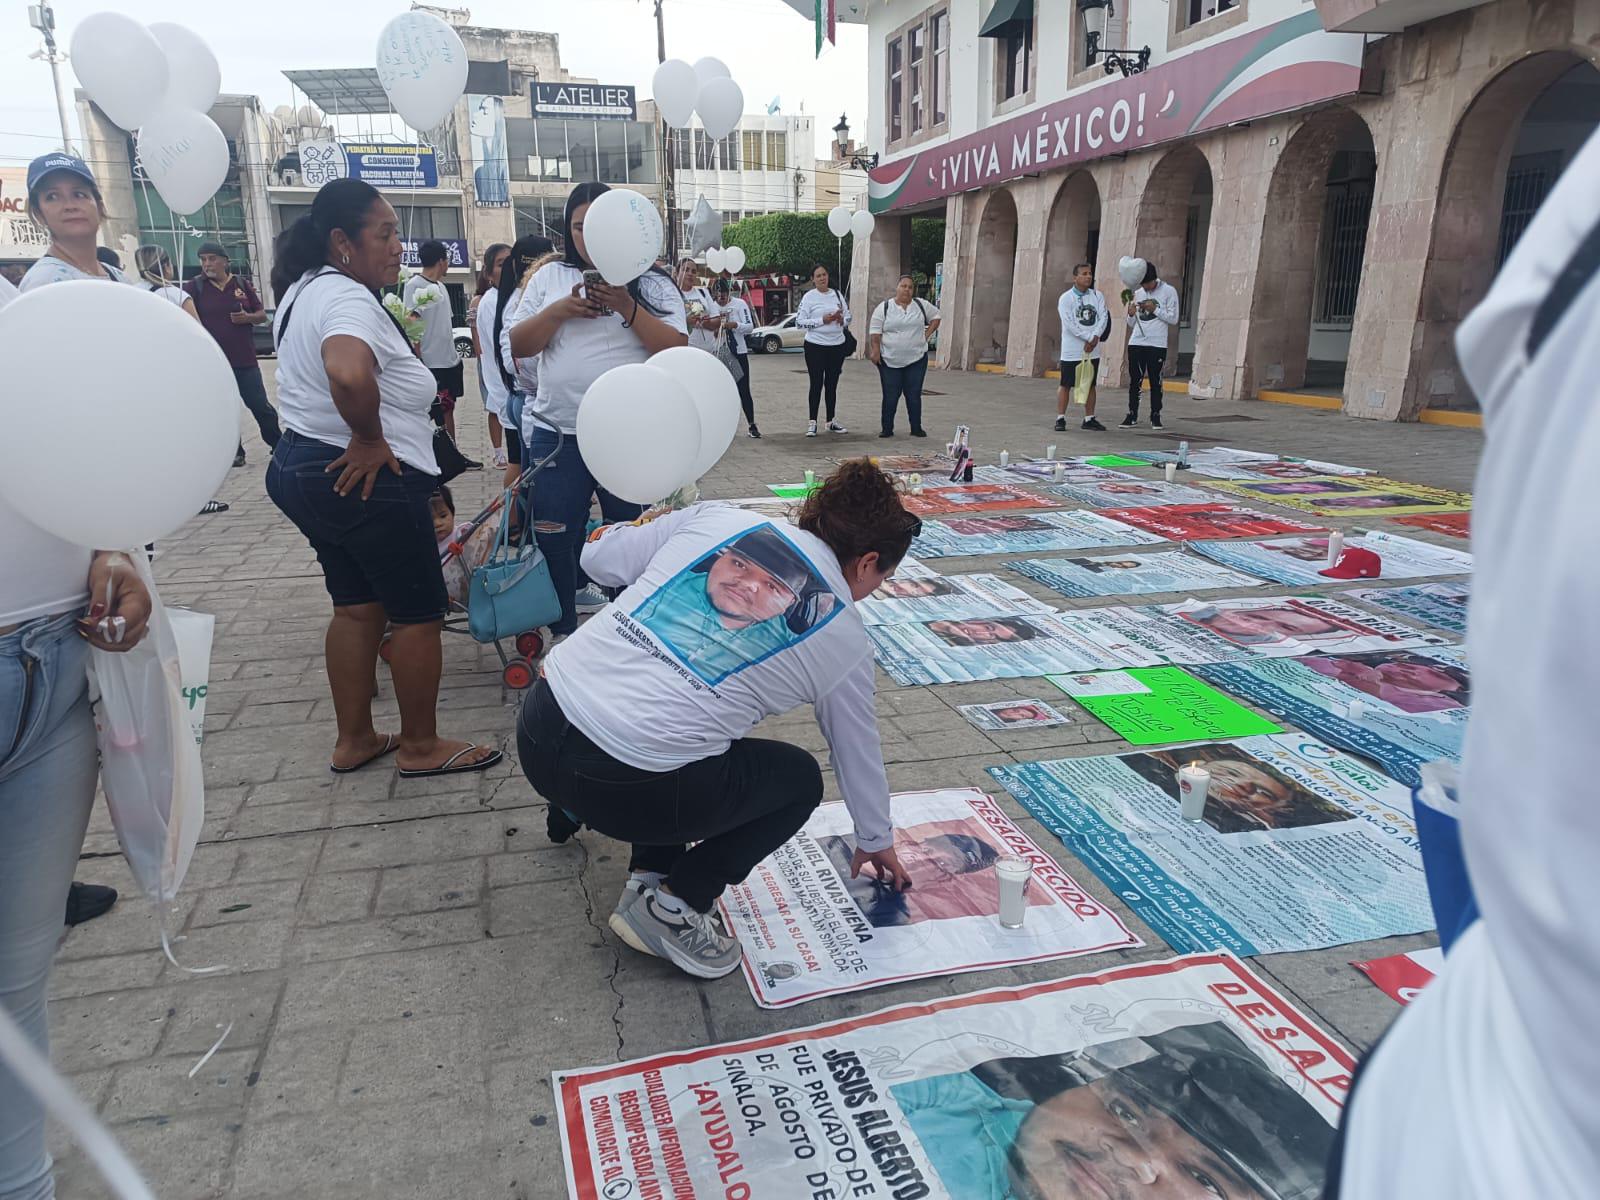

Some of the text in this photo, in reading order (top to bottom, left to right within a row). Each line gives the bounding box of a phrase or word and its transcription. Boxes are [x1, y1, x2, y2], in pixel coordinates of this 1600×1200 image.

[941, 92, 1146, 190] ¡VIVA MÉXICO!
[46, 159, 74, 168] PUMA
[360, 170, 392, 178] VACUNAS
[368, 156, 414, 166] CONSULTORIO
[612, 610, 630, 627] JESUS
[1282, 766, 1336, 798] CARLOS
[1324, 760, 1380, 792] Sinaloa
[792, 859, 805, 869] DE
[799, 870, 813, 882] SU
[967, 797, 1104, 920] DESAPARECIDO
[794, 831, 873, 943] DANIEL RIVAS MENA
[805, 884, 834, 919] LIBERTAD
[1137, 873, 1162, 896] muy
[1164, 883, 1190, 905] esta
[760, 872, 792, 916] REGRESAR
[789, 927, 804, 939] SU
[797, 942, 821, 972] CASA!
[777, 861, 795, 877] 2025
[787, 878, 802, 888] EN
[820, 933, 849, 972] SINALOA
[828, 921, 840, 932] EL
[836, 933, 852, 948] DIA
[851, 958, 868, 973] DE
[642, 1069, 674, 1127] CUALQUIER
[722, 1058, 766, 1138] SINALOA.
[756, 1053, 780, 1072] DE
[769, 1084, 816, 1160] AGOSTO
[588, 1095, 625, 1184] COMUNICATE AL
[618, 1090, 656, 1177] RECOMPENSADA
[788, 1045, 876, 1199] FUE PRIVADO DE
[822, 1048, 932, 1200] JESUS ALBERTO
[688, 1081, 752, 1200] ¡AYUDALO
